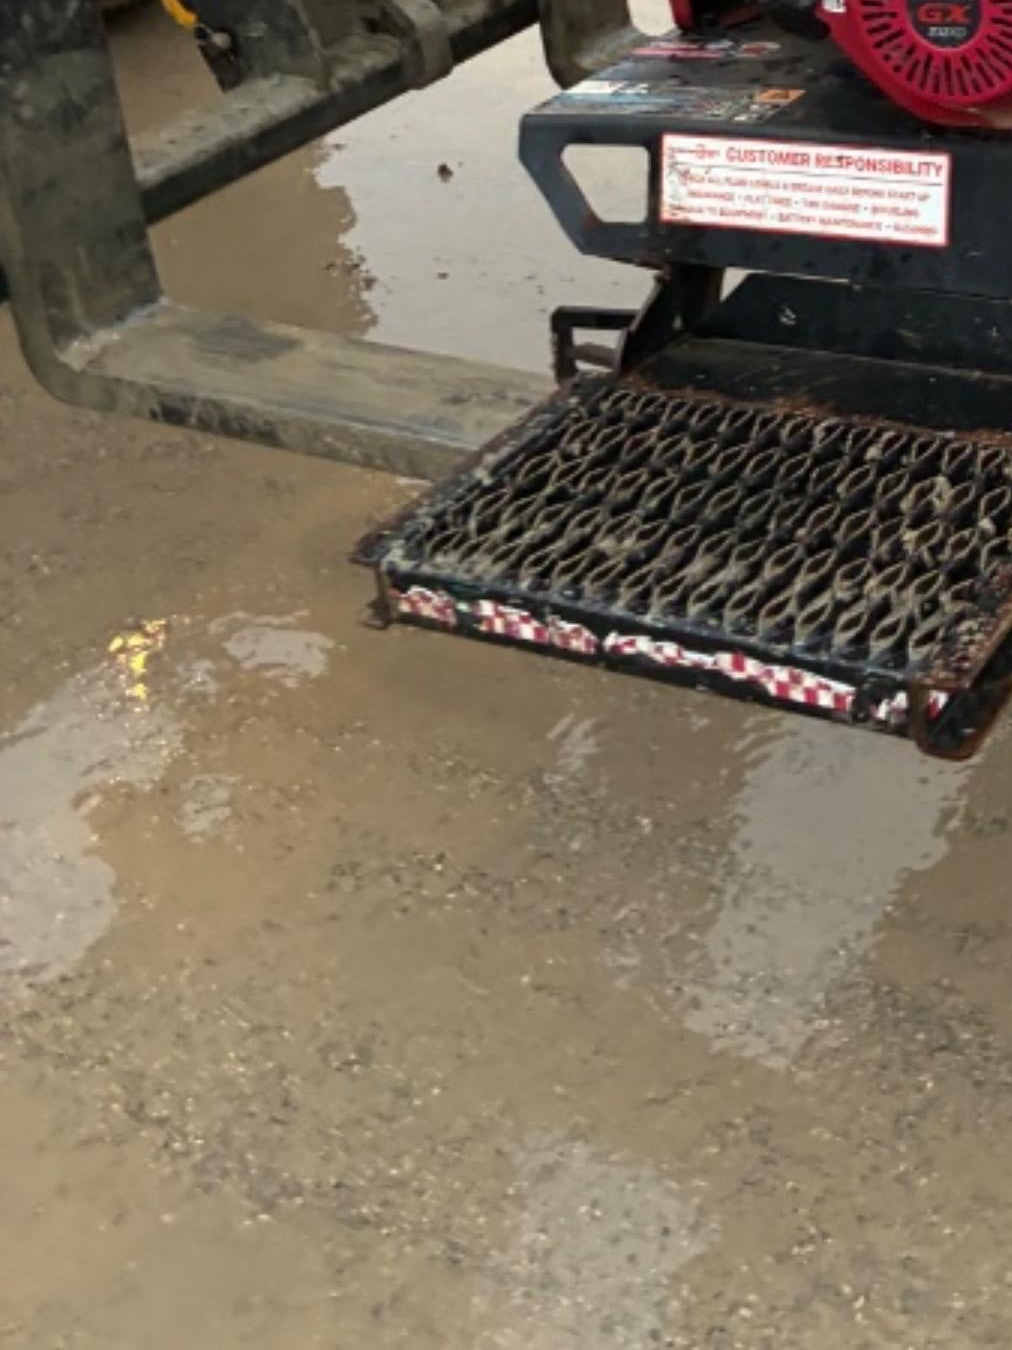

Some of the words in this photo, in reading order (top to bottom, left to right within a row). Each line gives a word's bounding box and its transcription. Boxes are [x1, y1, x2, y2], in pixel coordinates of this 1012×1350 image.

[917, 2, 971, 24] GX
[725, 146, 810, 167] CUSTOMER
[815, 153, 943, 177] RESPONSIBILITY
